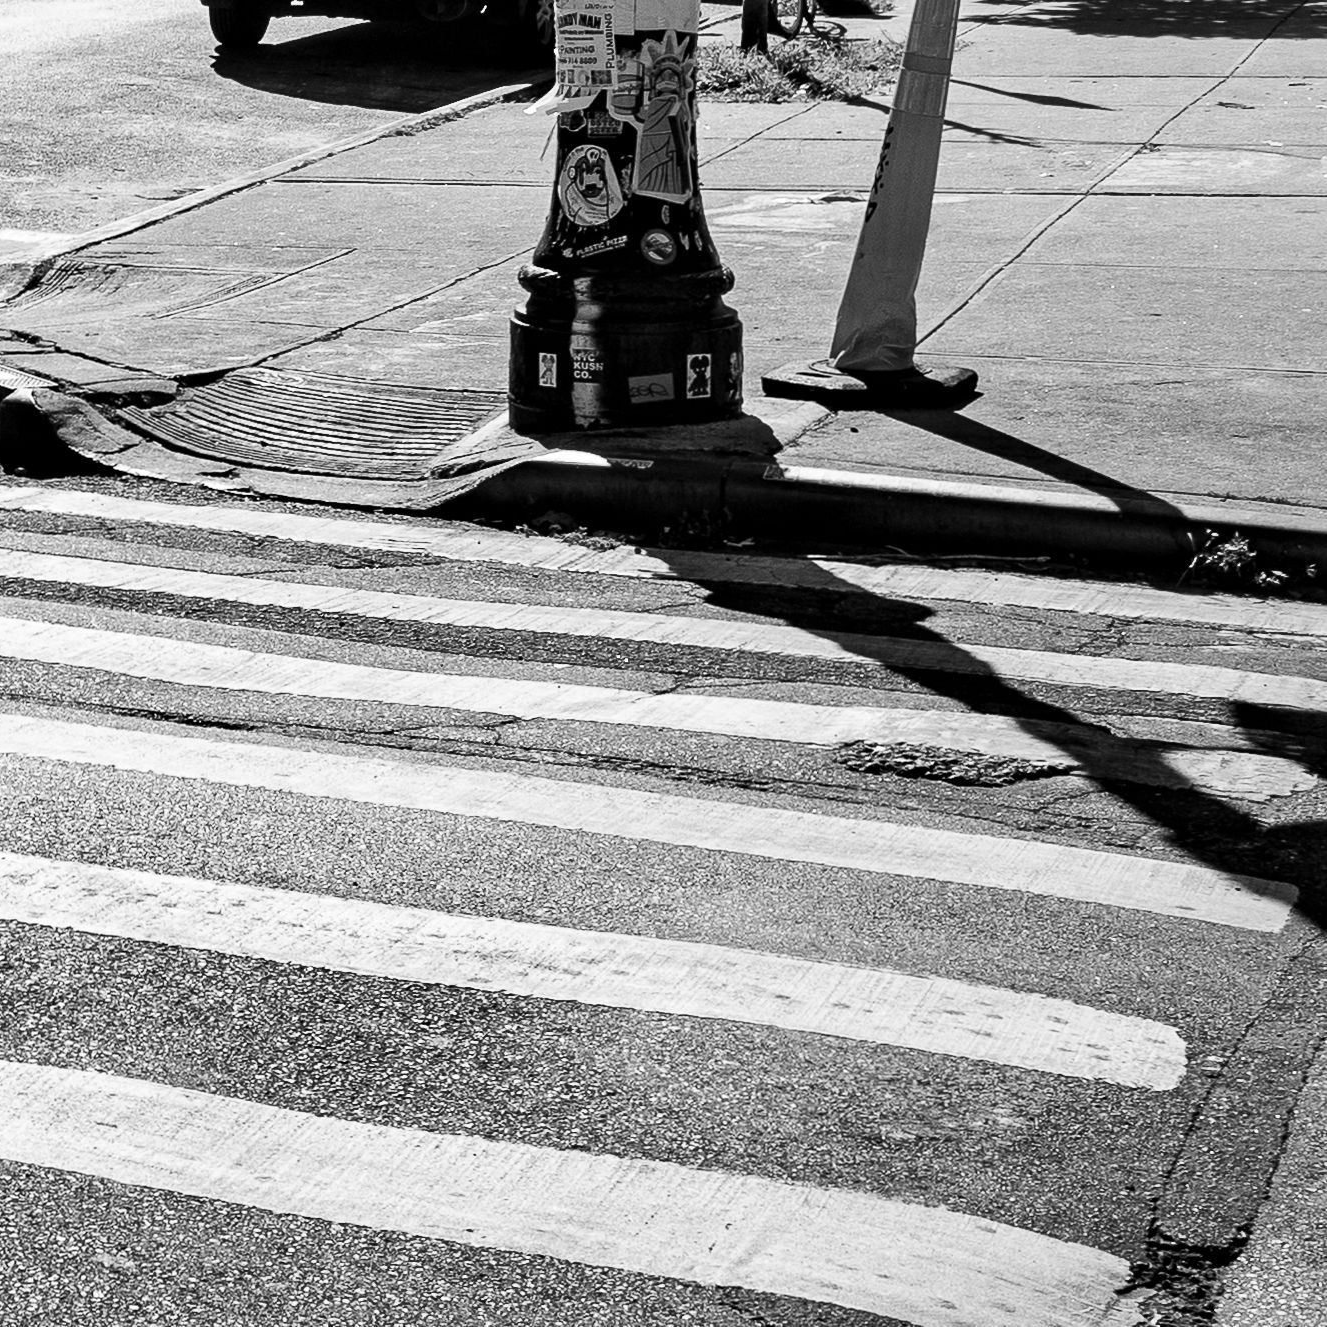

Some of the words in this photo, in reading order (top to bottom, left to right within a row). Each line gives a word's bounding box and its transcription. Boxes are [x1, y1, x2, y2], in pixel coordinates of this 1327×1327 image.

[604, 12, 615, 69] PLUMBING
[573, 361, 604, 371] KUSH
[573, 370, 593, 379] CO.
